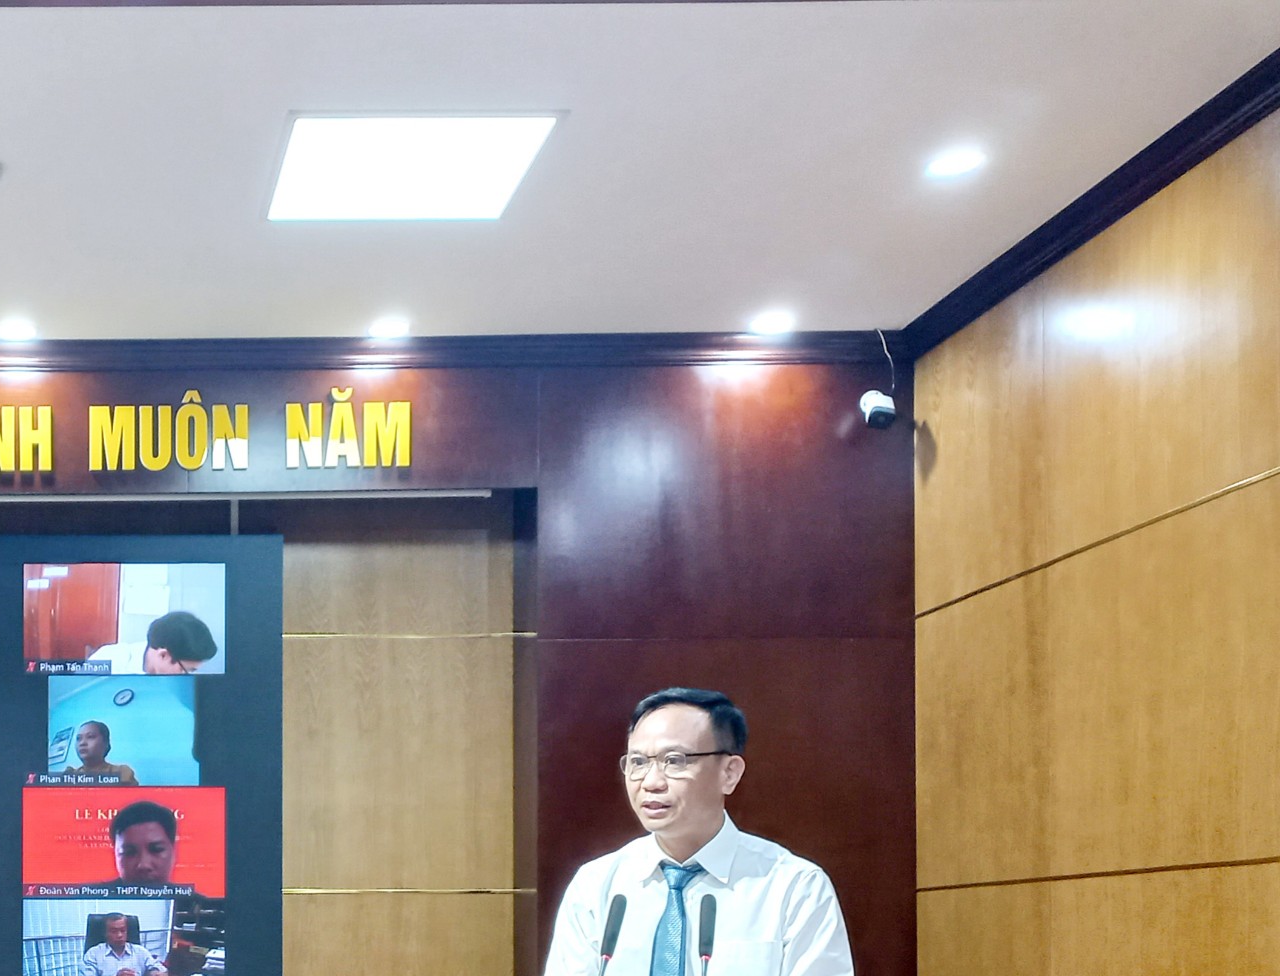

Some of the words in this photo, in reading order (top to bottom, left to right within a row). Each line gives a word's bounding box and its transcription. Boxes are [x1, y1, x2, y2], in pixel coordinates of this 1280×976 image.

[88, 390, 250, 472] MUÔN
[285, 386, 412, 470] NĂM
[39, 775, 61, 784] Phan
[77, 775, 94, 784] Kim
[98, 775, 120, 784] Loan
[81, 887, 109, 898] Phong
[116, 887, 139, 896] THPT
[140, 885, 174, 898] Nguyễn
